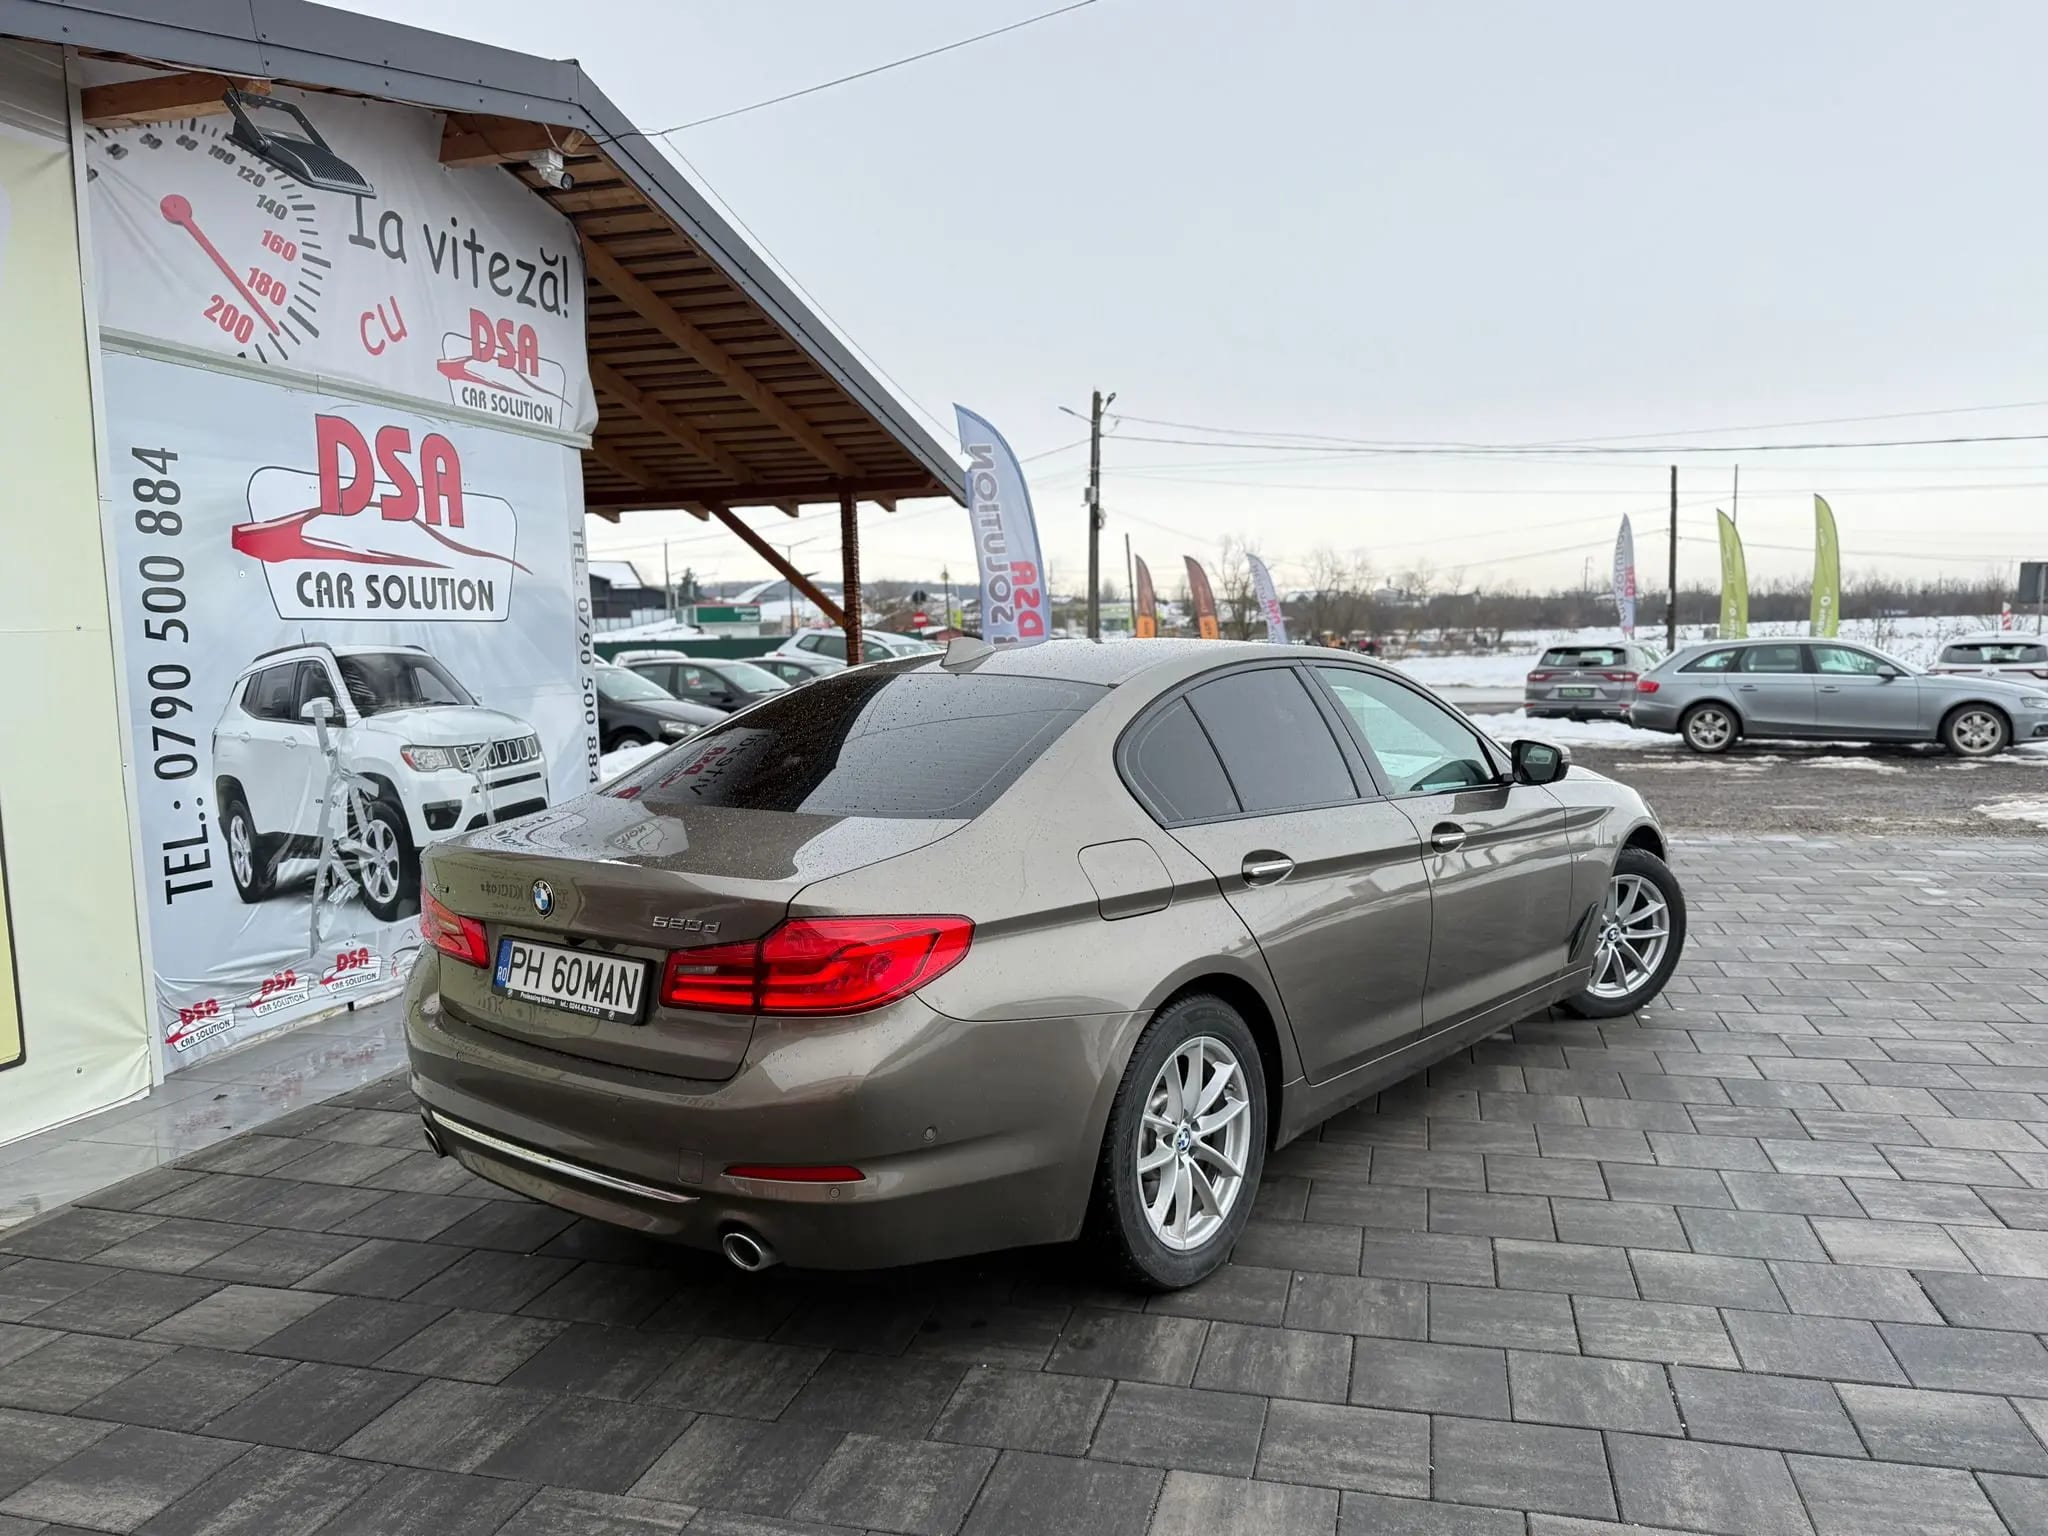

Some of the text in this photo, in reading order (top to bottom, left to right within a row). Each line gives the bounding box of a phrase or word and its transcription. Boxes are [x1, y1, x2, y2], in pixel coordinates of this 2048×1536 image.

[207, 144, 236, 165] 100
[237, 165, 266, 187] 120
[256, 194, 288, 220] 140
[261, 230, 298, 262] 160
[247, 267, 287, 306] 180
[423, 217, 568, 318] viteză!
[203, 294, 254, 344] 200
[469, 308, 539, 377] DSA
[462, 386, 553, 424] CAR SOLUTION
[314, 413, 464, 529] DSA
[296, 571, 494, 613] CAR SOLUTION
[577, 597, 592, 665] 0790
[131, 446, 213, 905] TEL.: 0790 500 884
[581, 677, 596, 725] 500
[587, 735, 599, 784] 884
[336, 947, 369, 972] DSA
[497, 966, 508, 982] RO
[508, 946, 545, 989] PH
[261, 969, 297, 995] DSA
[331, 972, 377, 991] CAR SOLUTION
[180, 998, 219, 1027] DSA
[258, 993, 305, 1014] CAR SOLUTION
[181, 1019, 231, 1048] CAR SOLUTION
